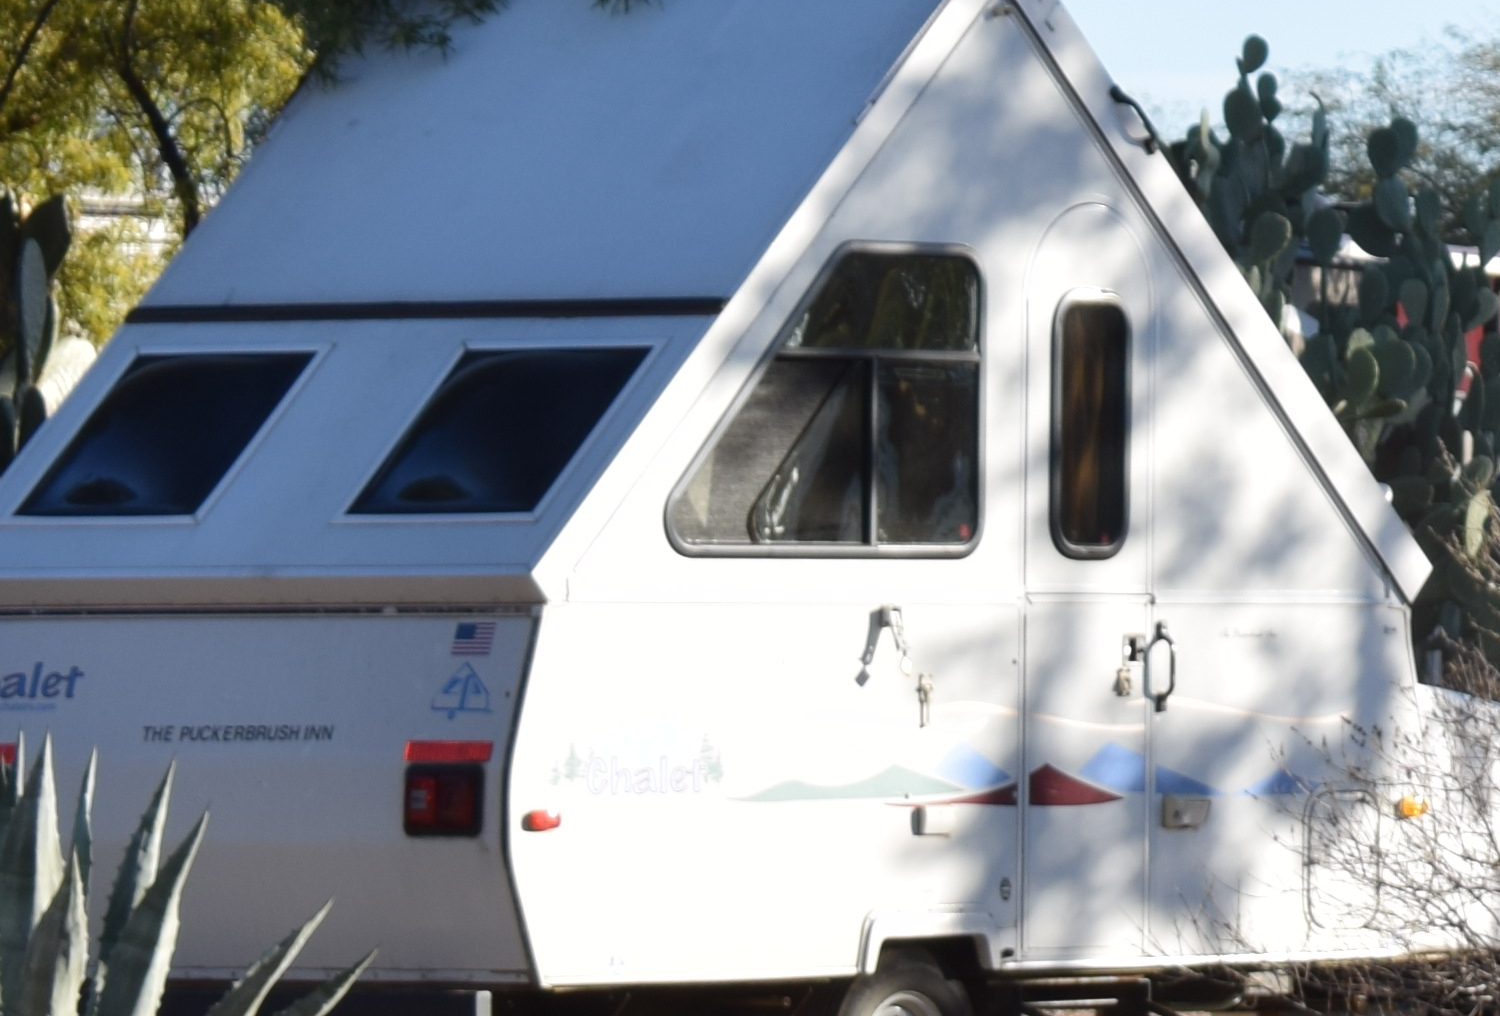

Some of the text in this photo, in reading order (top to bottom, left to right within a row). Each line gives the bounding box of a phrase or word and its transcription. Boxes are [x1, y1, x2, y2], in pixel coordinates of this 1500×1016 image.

[143, 724, 334, 742] THE PUCKERBRUSH INN
[586, 754, 708, 795] Chalet
